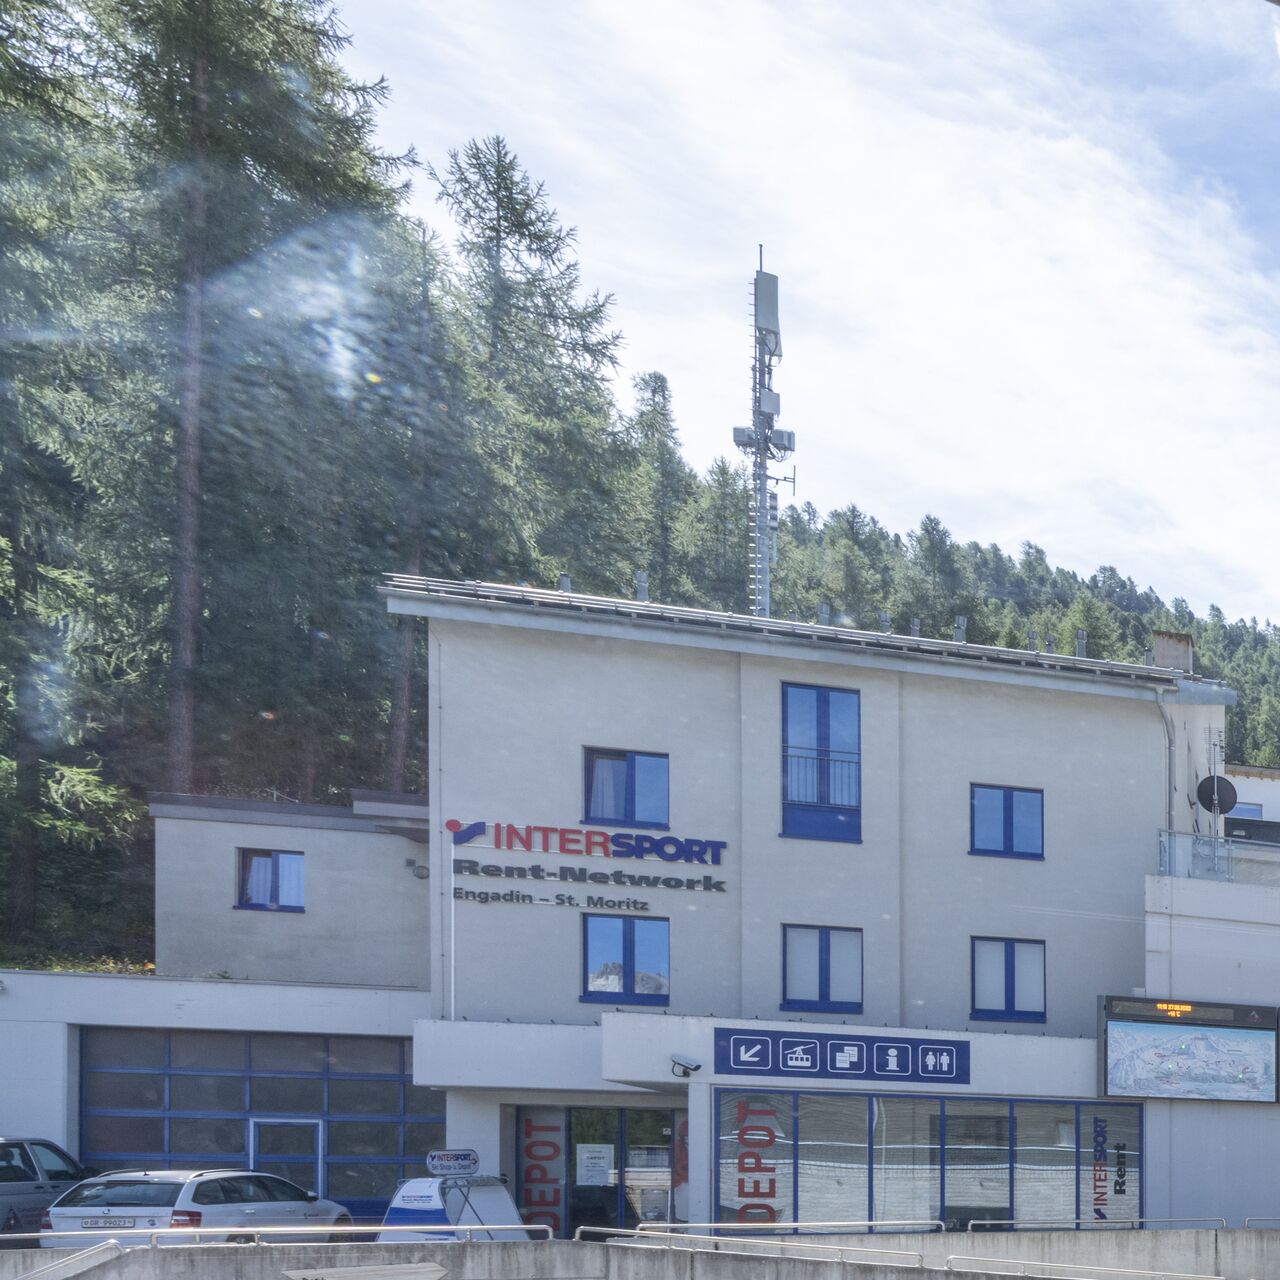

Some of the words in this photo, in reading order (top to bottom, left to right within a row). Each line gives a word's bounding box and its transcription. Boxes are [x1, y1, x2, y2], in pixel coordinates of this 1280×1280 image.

[494, 822, 727, 865] INTERSPORT
[453, 858, 727, 893] Rent-Network
[453, 887, 533, 905] Engadin
[555, 893, 580, 907] St.
[586, 895, 649, 911] Moritz
[437, 1153, 471, 1161] INTERSPORT
[524, 1118, 560, 1232] DEPOT
[738, 1101, 776, 1224] DEPOT
[1093, 1116, 1107, 1206] INTERSPORT
[1114, 1143, 1126, 1195] Rent
